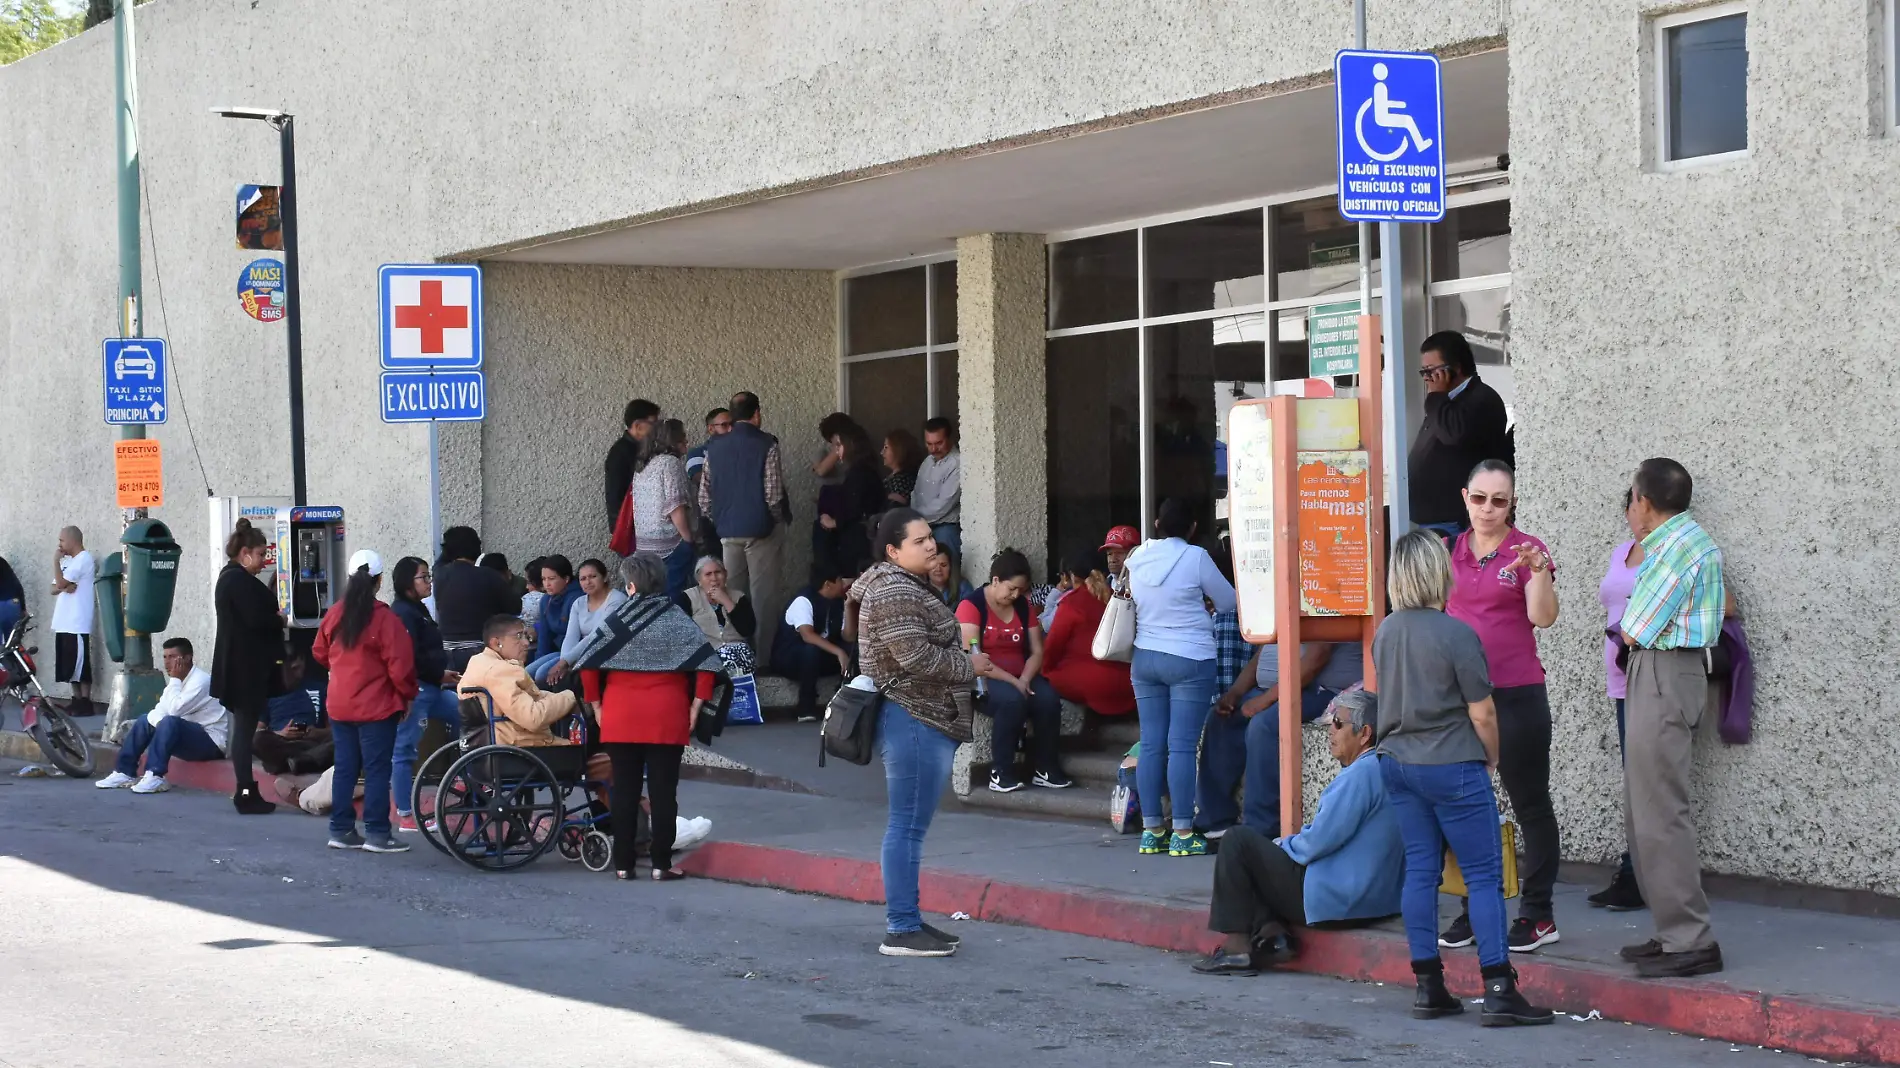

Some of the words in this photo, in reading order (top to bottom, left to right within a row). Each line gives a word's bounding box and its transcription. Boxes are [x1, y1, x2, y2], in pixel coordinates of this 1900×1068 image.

[1346, 160, 1380, 176] CAJÓN
[1383, 165, 1437, 178] EXCLUSIVO
[1349, 177, 1405, 194] VEHÍCULOS
[1411, 182, 1431, 194] CON
[1345, 199, 1400, 211] DISTINTIVO
[1402, 200, 1440, 213] OFICIAL
[1328, 247, 1351, 260] TRIAGE
[261, 309, 282, 319] SMS
[108, 386, 130, 394] TAXI
[139, 386, 162, 394] SITIO
[117, 394, 153, 402] PLAZA
[386, 381, 479, 412] EXCLUSIVO
[107, 408, 149, 421] PRINCIPIA
[117, 446, 158, 454] EFECTIVO
[119, 482, 130, 492] 461
[132, 481, 143, 492] 218
[144, 480, 159, 491] 4709
[1318, 488, 1350, 498] menos
[305, 510, 341, 519] MONEDAS
[1302, 579, 1319, 592] $10
